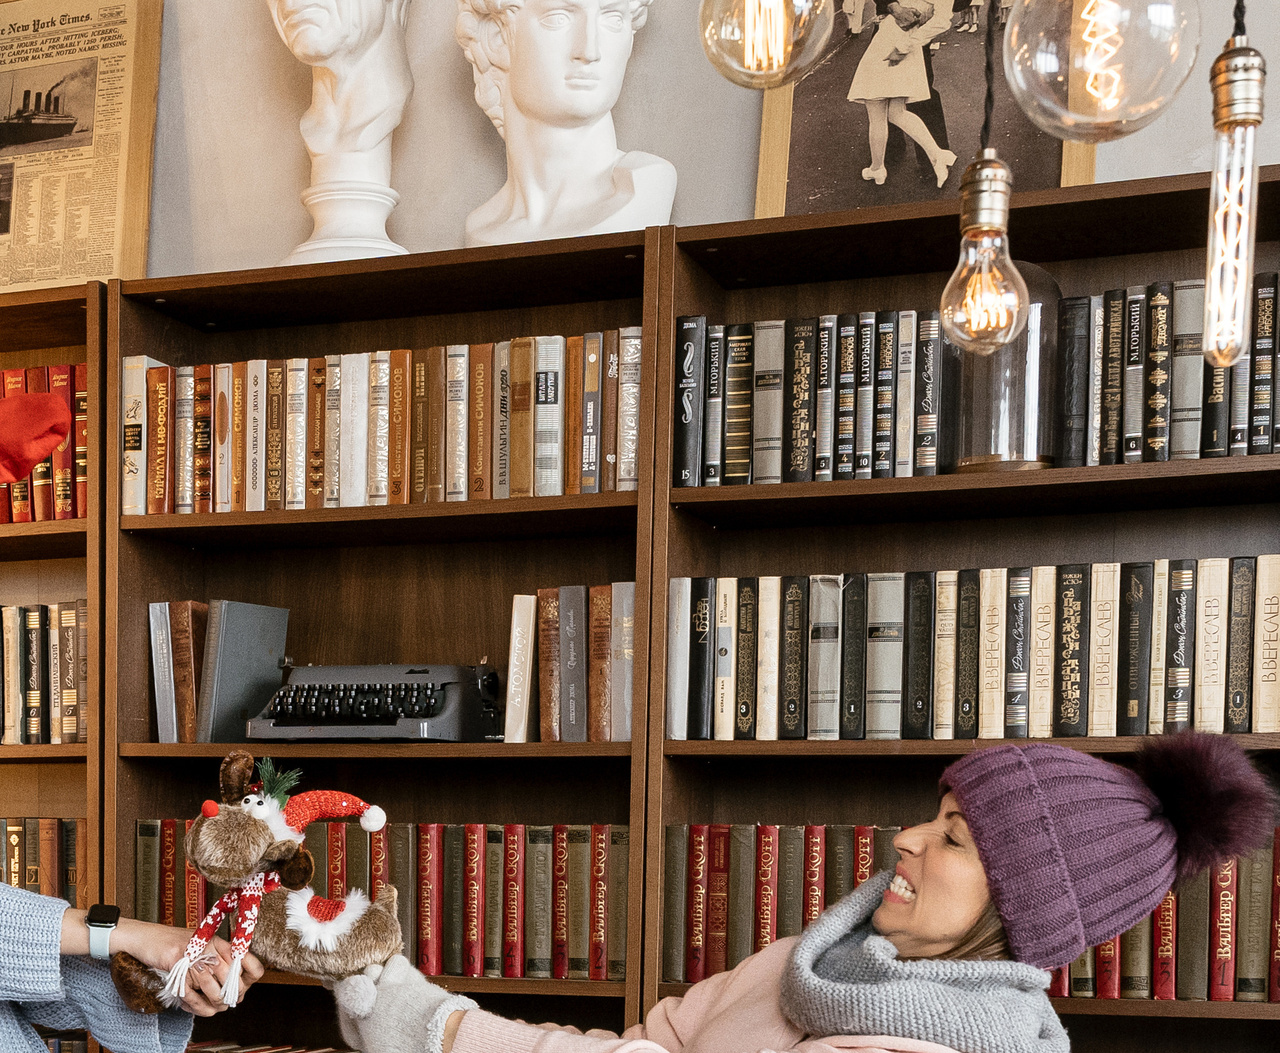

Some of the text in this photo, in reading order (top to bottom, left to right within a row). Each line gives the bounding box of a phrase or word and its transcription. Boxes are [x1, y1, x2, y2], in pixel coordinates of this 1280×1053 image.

[7, 22, 31, 36] New
[32, 16, 57, 33] York
[59, 13, 93, 27] Times.
[16, 41, 38, 49] HOURS
[39, 37, 61, 47] AFTER
[62, 32, 89, 42] HITTING
[8, 55, 30, 64] ASTOR
[55, 47, 77, 57] NOTED
[78, 44, 100, 54] NAMES
[101, 39, 128, 50] MISSING
[47, 41, 81, 52] PROBABLY
[83, 38, 97, 47] 1250
[1130, 303, 1140, 361] М.ГОРЬКИЙ
[1263, 298, 1273, 337] НАБОКОВ
[819, 330, 829, 385] М.ГОРЬКИЙ
[846, 336, 855, 373] НАБОКОВ
[861, 326, 871, 382] М.ГОРЬКИЙ
[885, 332, 894, 368] НАБОКОВ
[1107, 299, 1123, 386] АННА АВСТРИЙСКАЯ
[709, 340, 720, 395] М.ГОРЬКИЙ
[233, 377, 243, 432] СИМОНОВ
[393, 367, 403, 423] СИМОНОВ
[474, 362, 485, 475] Константин СИМОНОВ
[1212, 430, 1218, 442] 1
[1234, 432, 1242, 442] 4
[1258, 425, 1265, 435] 1
[156, 445, 166, 456] И
[819, 458, 826, 468] 5
[841, 453, 849, 463] 4
[859, 458, 868, 467] 10
[878, 451, 886, 460] 2
[1129, 440, 1136, 449] 6
[391, 480, 402, 496] 3
[474, 477, 484, 492] 2
[681, 469, 691, 480] 15
[709, 467, 716, 477] 3
[985, 606, 1000, 690] В.ВЕРЕСАЕВ
[1036, 604, 1051, 688] В.ВЕРЕСАЕВ
[1095, 601, 1112, 686] В.ВЕРЕСАЕВ
[1128, 610, 1140, 690] ОТВЕРЖЕННЫЕ
[1203, 597, 1220, 684] В.ВЕРЕСАЕВ
[1261, 595, 1279, 684] В.ВЕРЕСАЕВ
[740, 704, 747, 713] 3
[788, 703, 795, 712] 2
[849, 704, 856, 713] 1
[916, 700, 923, 709] 2
[962, 702, 970, 712] 3
[330, 831, 343, 876] СКОТТ
[758, 834, 774, 884] СКОТТ
[806, 835, 823, 883] СКОТТ
[419, 832, 433, 941] ВАЛЬТЕР СКОТТ
[466, 832, 480, 942] ВАЛЬТЕР СКОТТ
[505, 833, 521, 942] ВАЛЬТЕР СКОТТ
[554, 831, 569, 941] ВАЛЬТЕР СКОТТ
[592, 832, 607, 943] ВАЛЬТЕР СКОТТ
[690, 834, 706, 948] ВАЛЬТЕР СКОТТ
[1216, 891, 1234, 960] ВАЛЬТЕР
